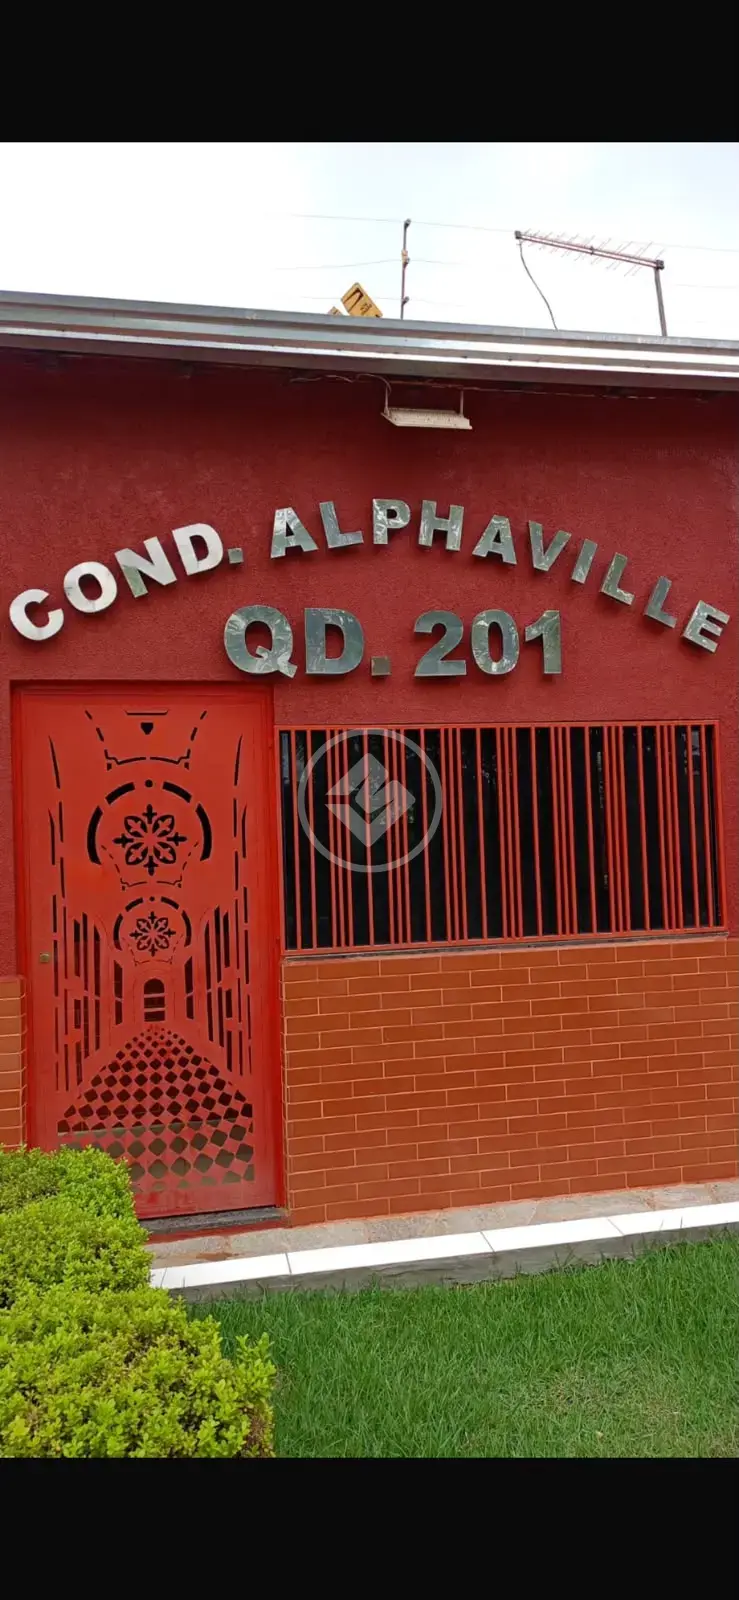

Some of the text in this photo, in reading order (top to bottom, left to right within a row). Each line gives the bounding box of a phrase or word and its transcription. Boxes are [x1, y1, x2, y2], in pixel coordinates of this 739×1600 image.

[9, 498, 730, 653] COND. ALPHAVILLE
[224, 605, 562, 677] QD. 201
